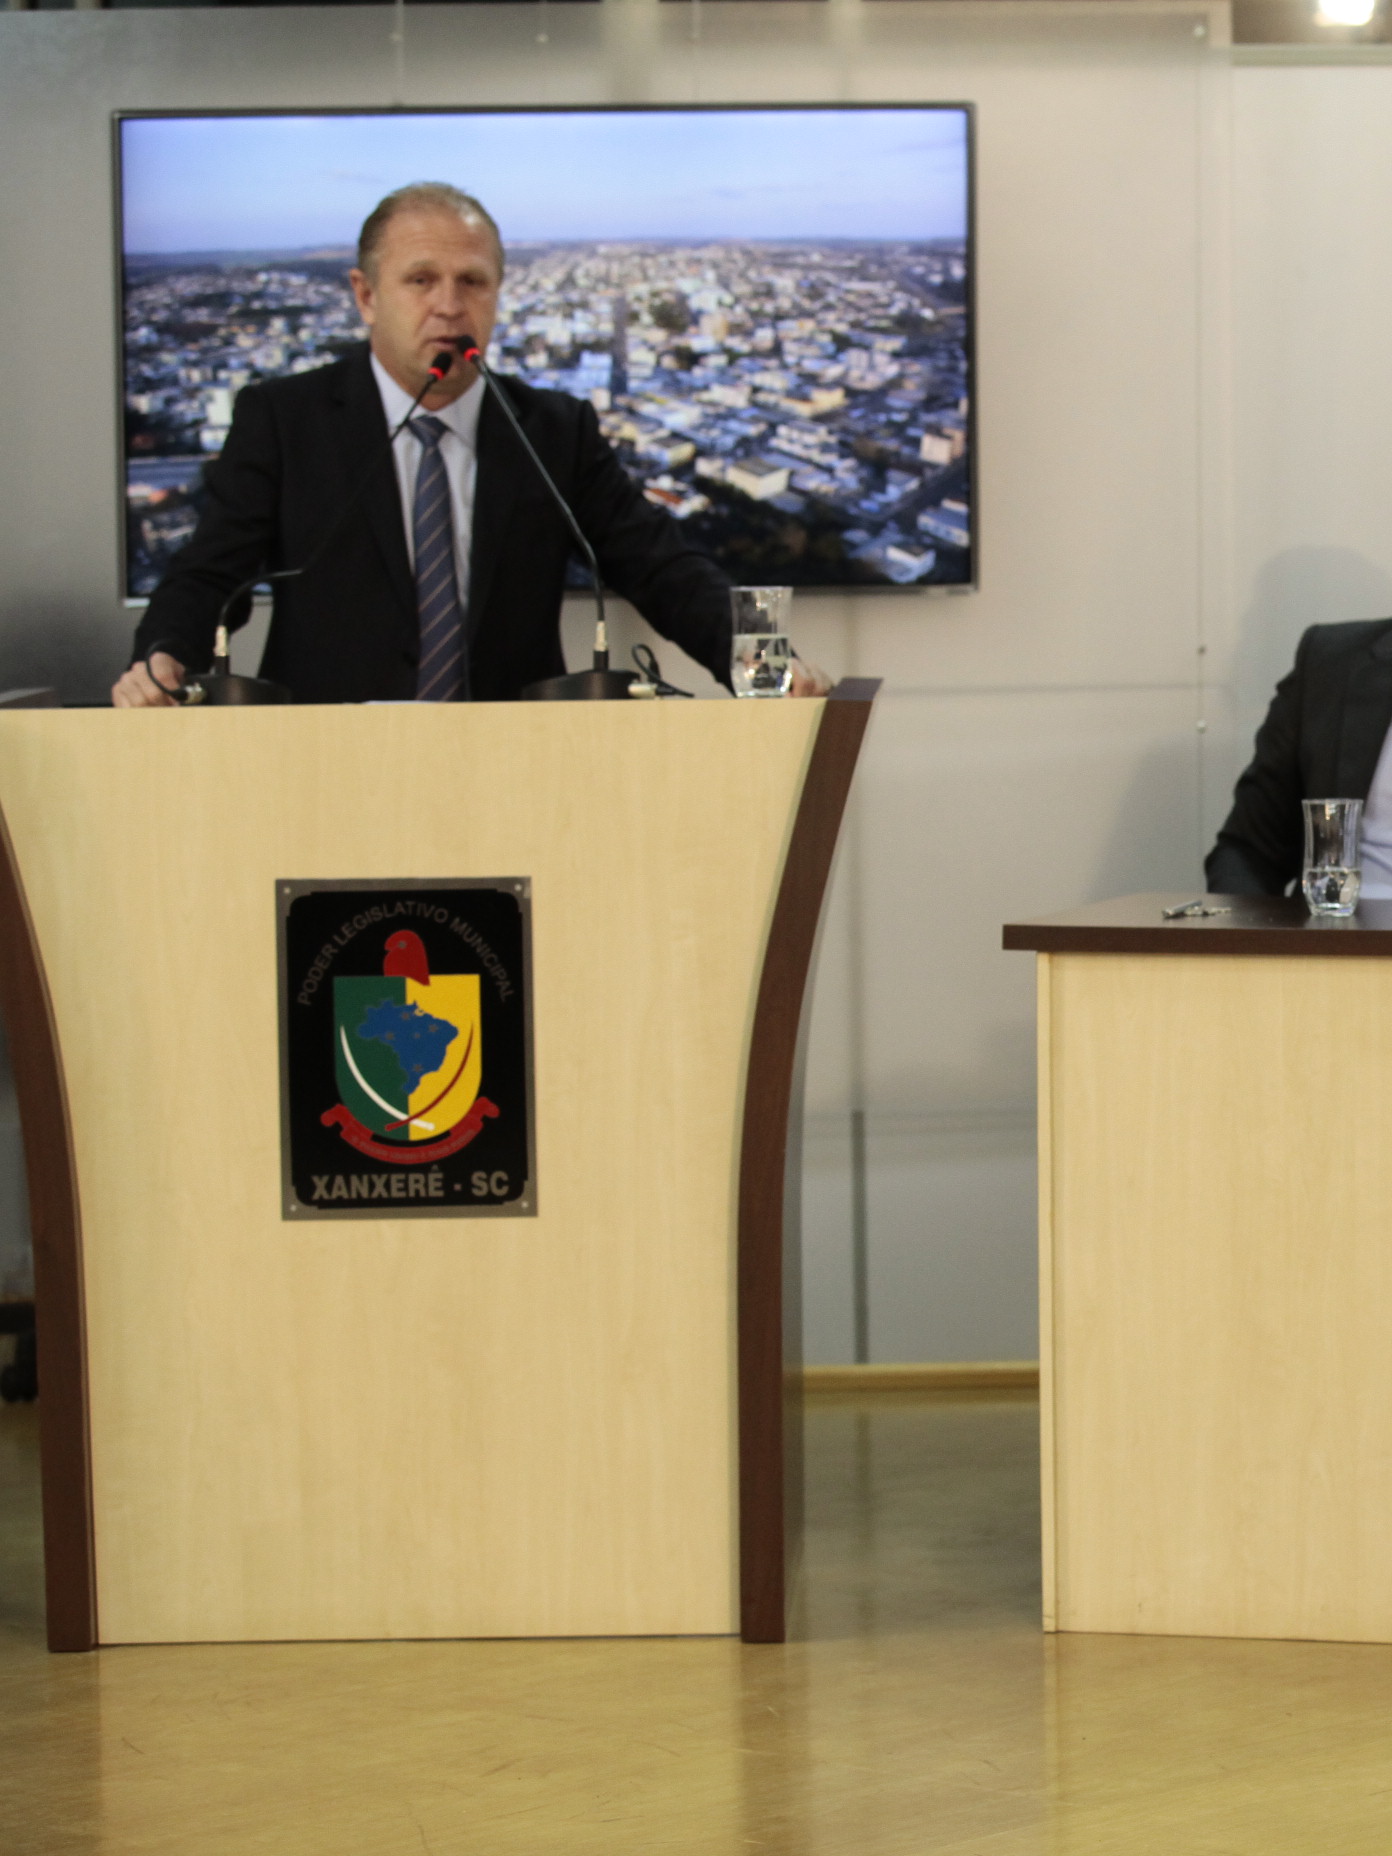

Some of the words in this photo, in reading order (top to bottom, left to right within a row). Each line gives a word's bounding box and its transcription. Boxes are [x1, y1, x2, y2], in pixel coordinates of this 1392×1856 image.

[298, 943, 338, 1005] PODER
[332, 900, 449, 946] LEGISLATIVO
[450, 917, 515, 1003] MUNICIPAL
[311, 1164, 444, 1200] XANXERÊ
[471, 1171, 509, 1197] SC
